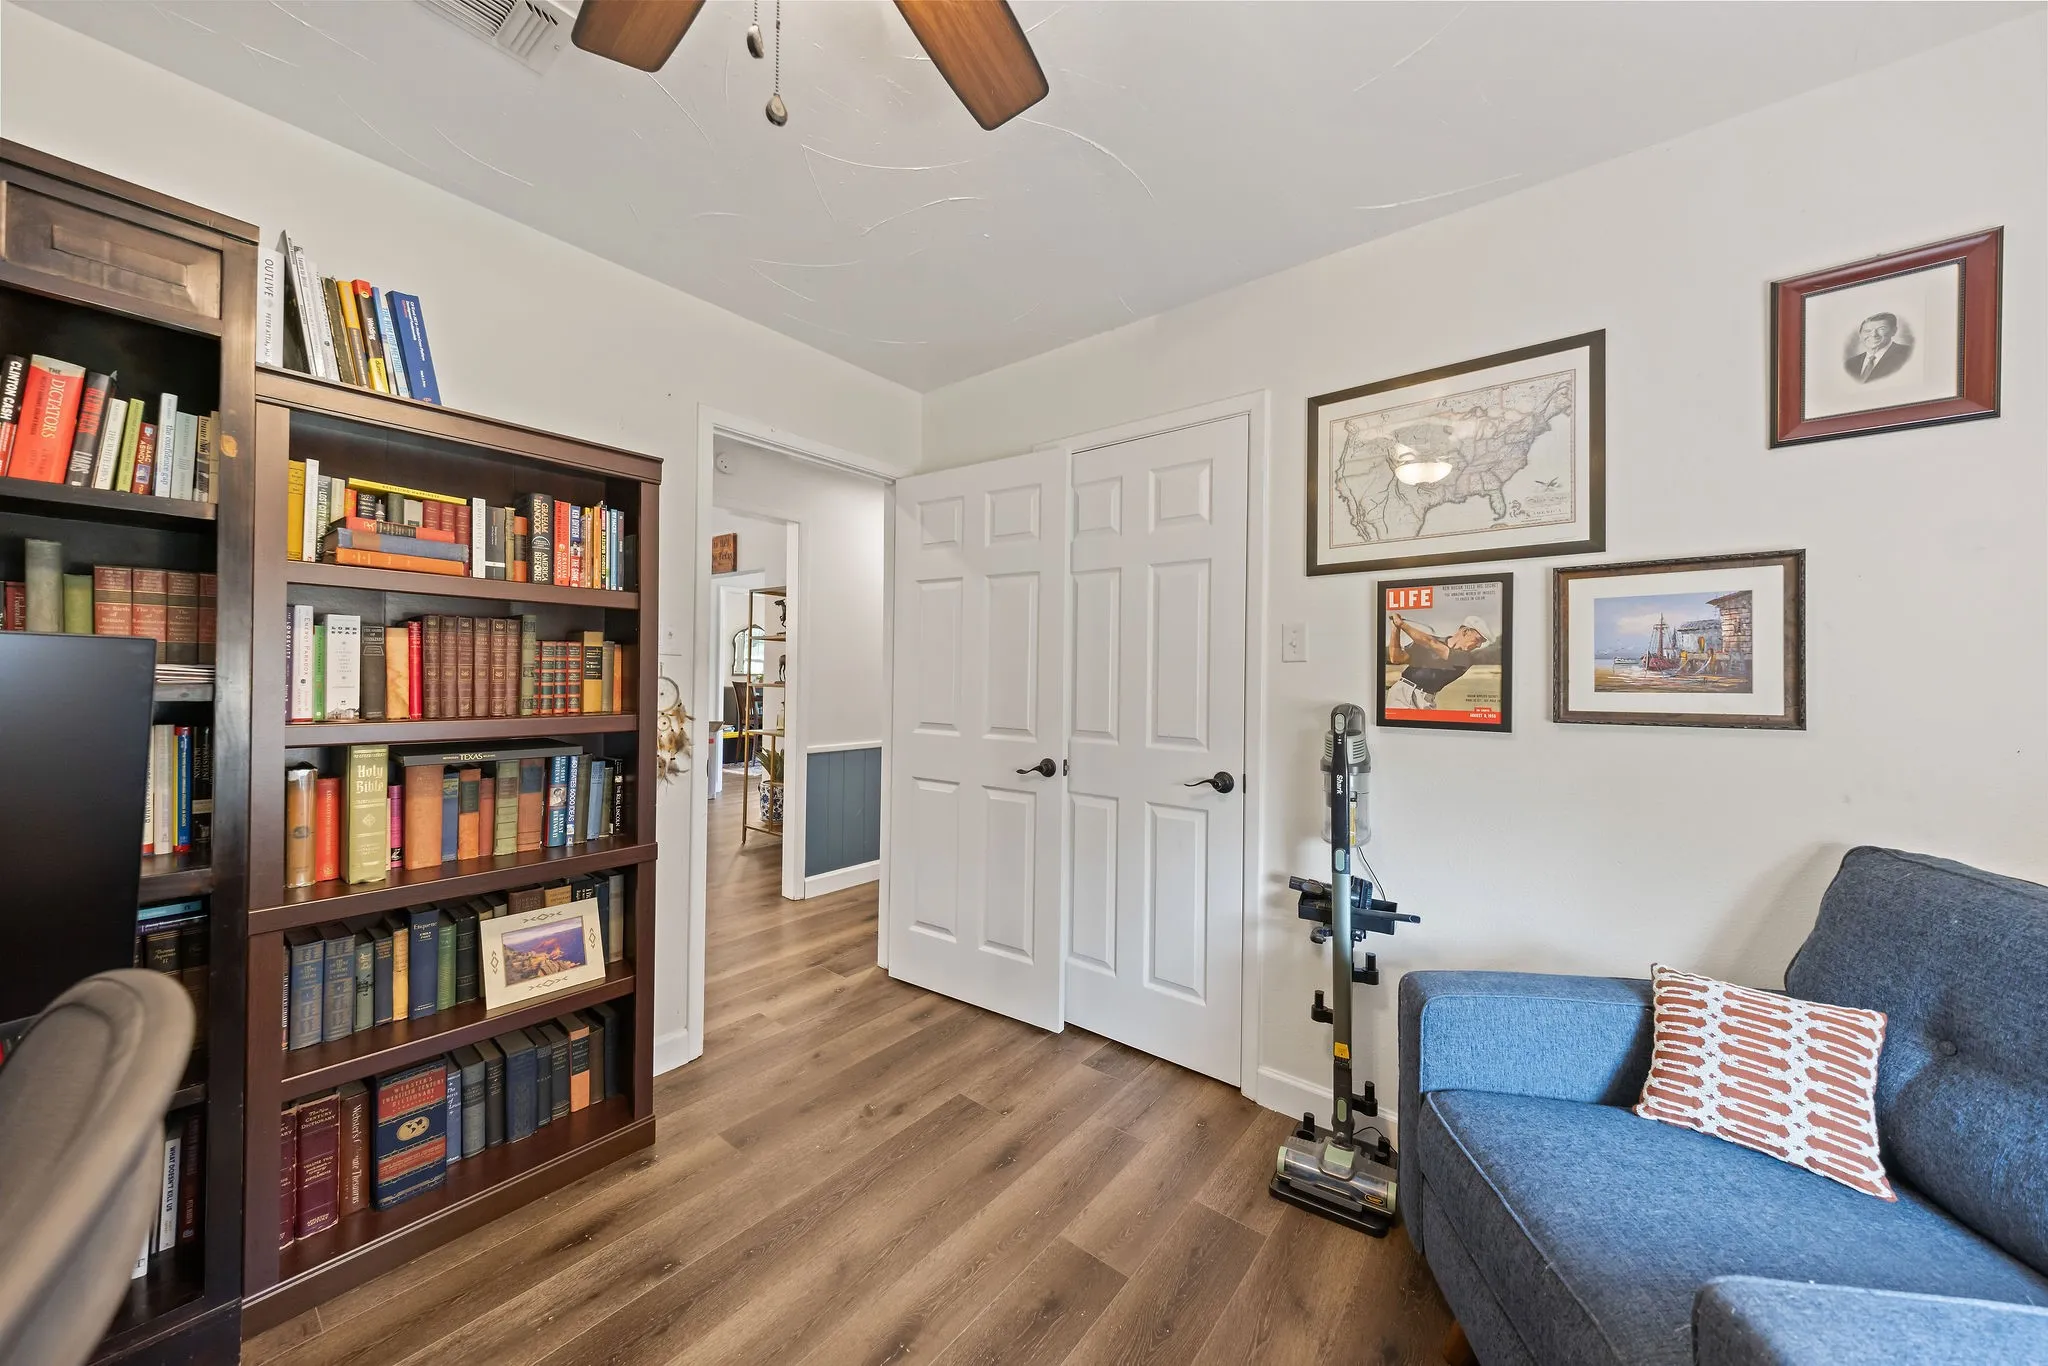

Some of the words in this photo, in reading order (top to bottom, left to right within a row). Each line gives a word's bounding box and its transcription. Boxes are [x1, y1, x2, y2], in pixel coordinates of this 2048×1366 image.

[264, 259, 274, 297] OUTLIVE
[367, 317, 376, 341] Welding
[5, 360, 22, 397] CLINTON
[48, 367, 62, 375] THE
[0, 397, 15, 421] CASH
[41, 379, 66, 439] DICTATORS
[165, 425, 174, 437] the
[137, 440, 146, 464] ASIMOV
[145, 443, 153, 463] ISAAC
[163, 436, 173, 472] confidence
[70, 450, 93, 475] LIARS
[160, 472, 170, 486] gap
[318, 490, 328, 504] LOST
[317, 504, 327, 517] CITY
[533, 499, 542, 535] HANCOCK
[541, 502, 549, 534] GRAHAM
[571, 509, 580, 519] KEN
[571, 518, 580, 538] DRYDEN
[533, 551, 542, 582] BEFORE
[541, 552, 549, 582] AMERICA
[1388, 589, 1431, 609] LIFE
[459, 752, 483, 761] TEXAS
[357, 764, 384, 779] Holy
[570, 768, 578, 788] STATES
[355, 780, 384, 794] Bible
[1336, 774, 1344, 795] Shark
[568, 804, 576, 822] IDEAS
[382, 1087, 417, 1105] TWENTIETH
[417, 1078, 445, 1093] CENTURY
[393, 1076, 434, 1094] WEBSTER'S
[391, 1088, 435, 1108] DICTIONARY
[301, 1114, 337, 1130] DICTIONARY
[305, 1110, 333, 1123] CENTURY
[352, 1103, 362, 1139] Webster's
[168, 1145, 177, 1164] WHAT
[303, 1159, 322, 1170] VOLUME
[322, 1155, 334, 1163] TWO
[167, 1163, 176, 1189] DOESN'T
[352, 1168, 363, 1204] Thesaurus
[166, 1188, 175, 1203] KILL
[166, 1202, 173, 1212] US
